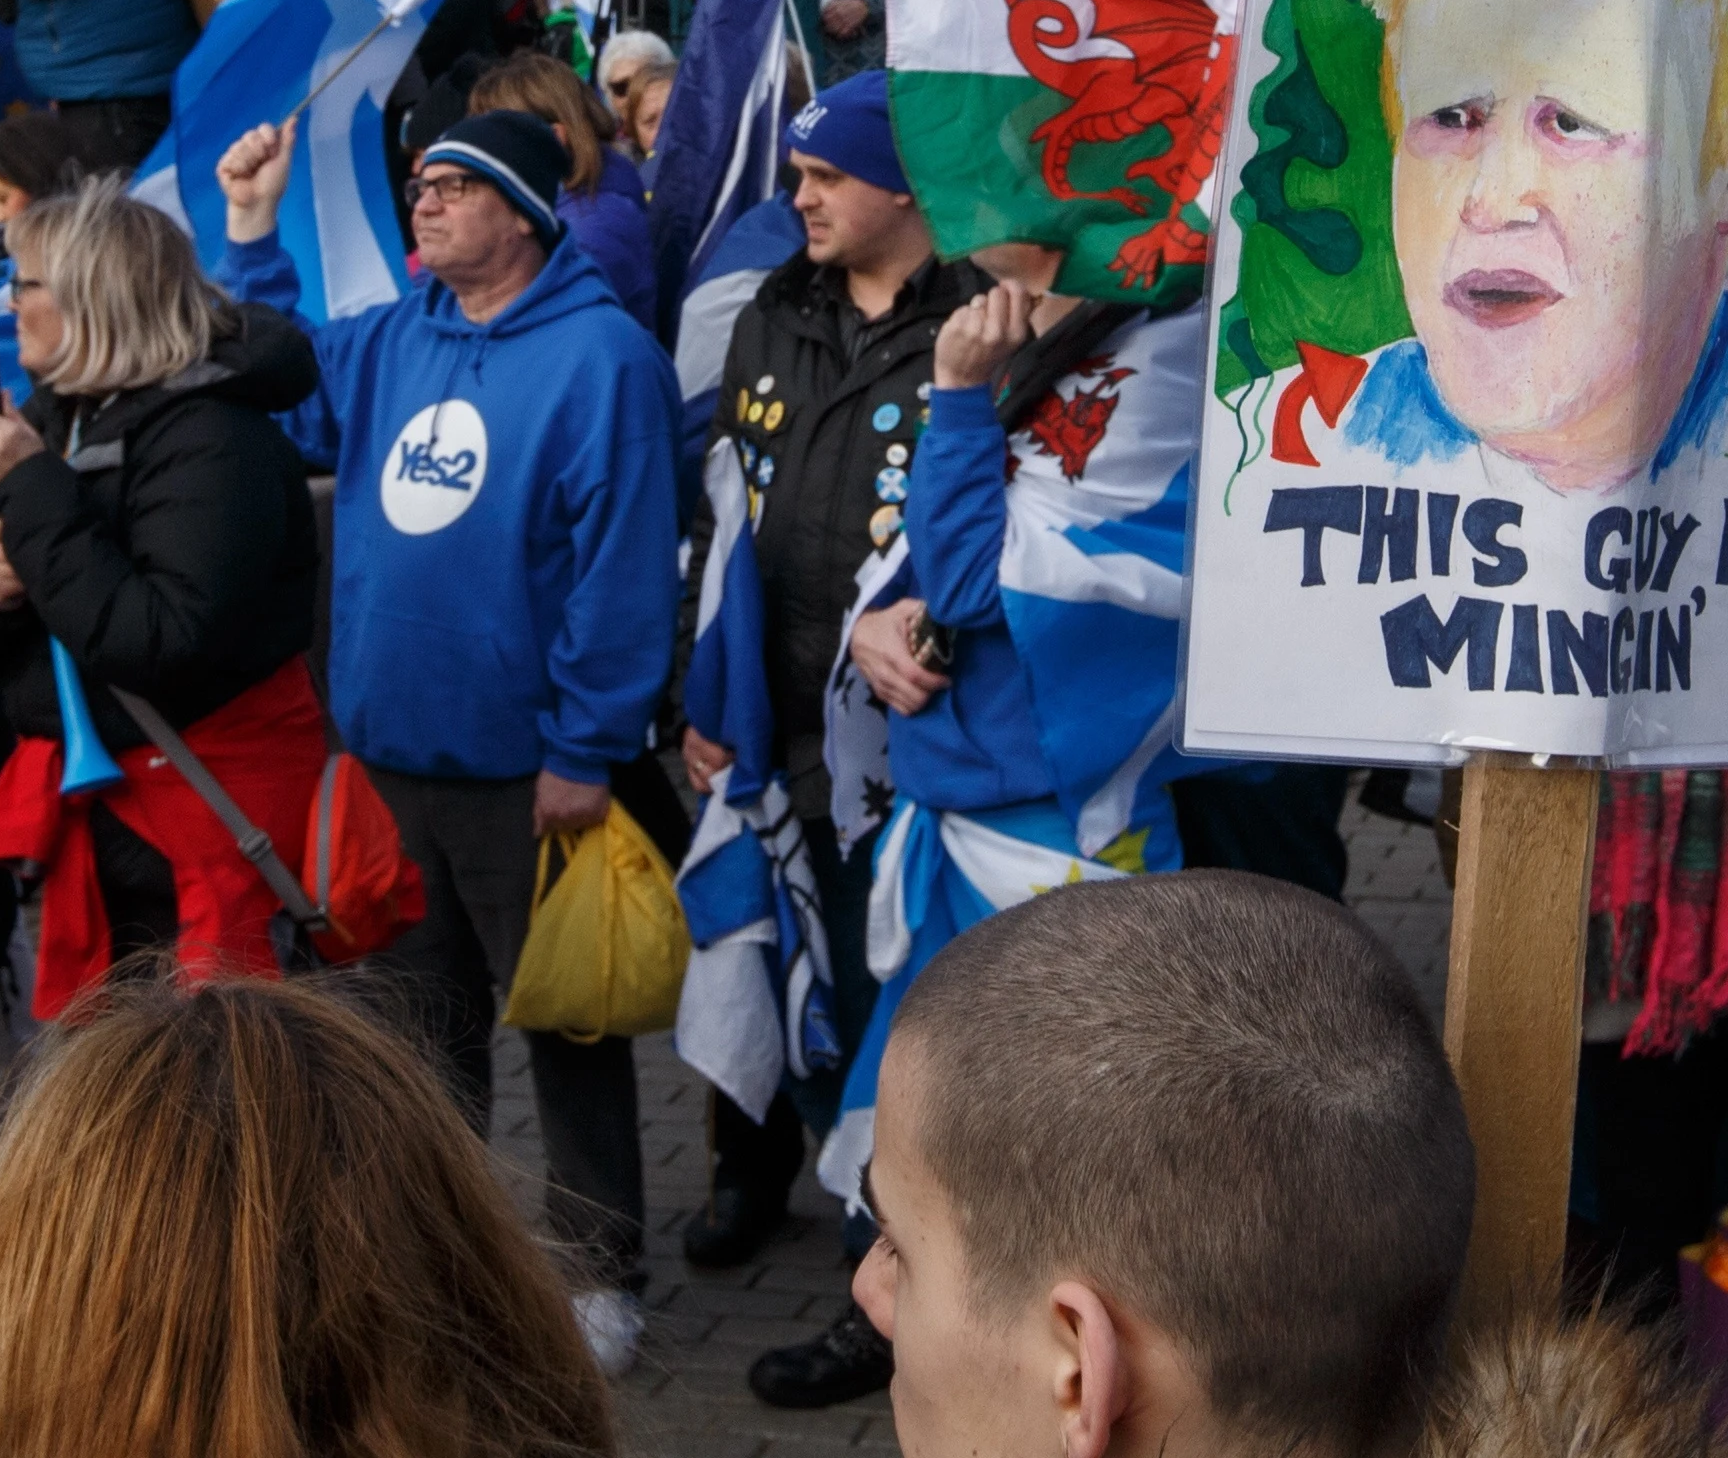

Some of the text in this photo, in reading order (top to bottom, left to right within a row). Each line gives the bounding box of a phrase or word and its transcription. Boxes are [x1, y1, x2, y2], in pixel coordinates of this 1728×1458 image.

[396, 441, 477, 492] Yes2
[1262, 484, 1529, 588] THIS
[1583, 504, 1702, 595] GUY
